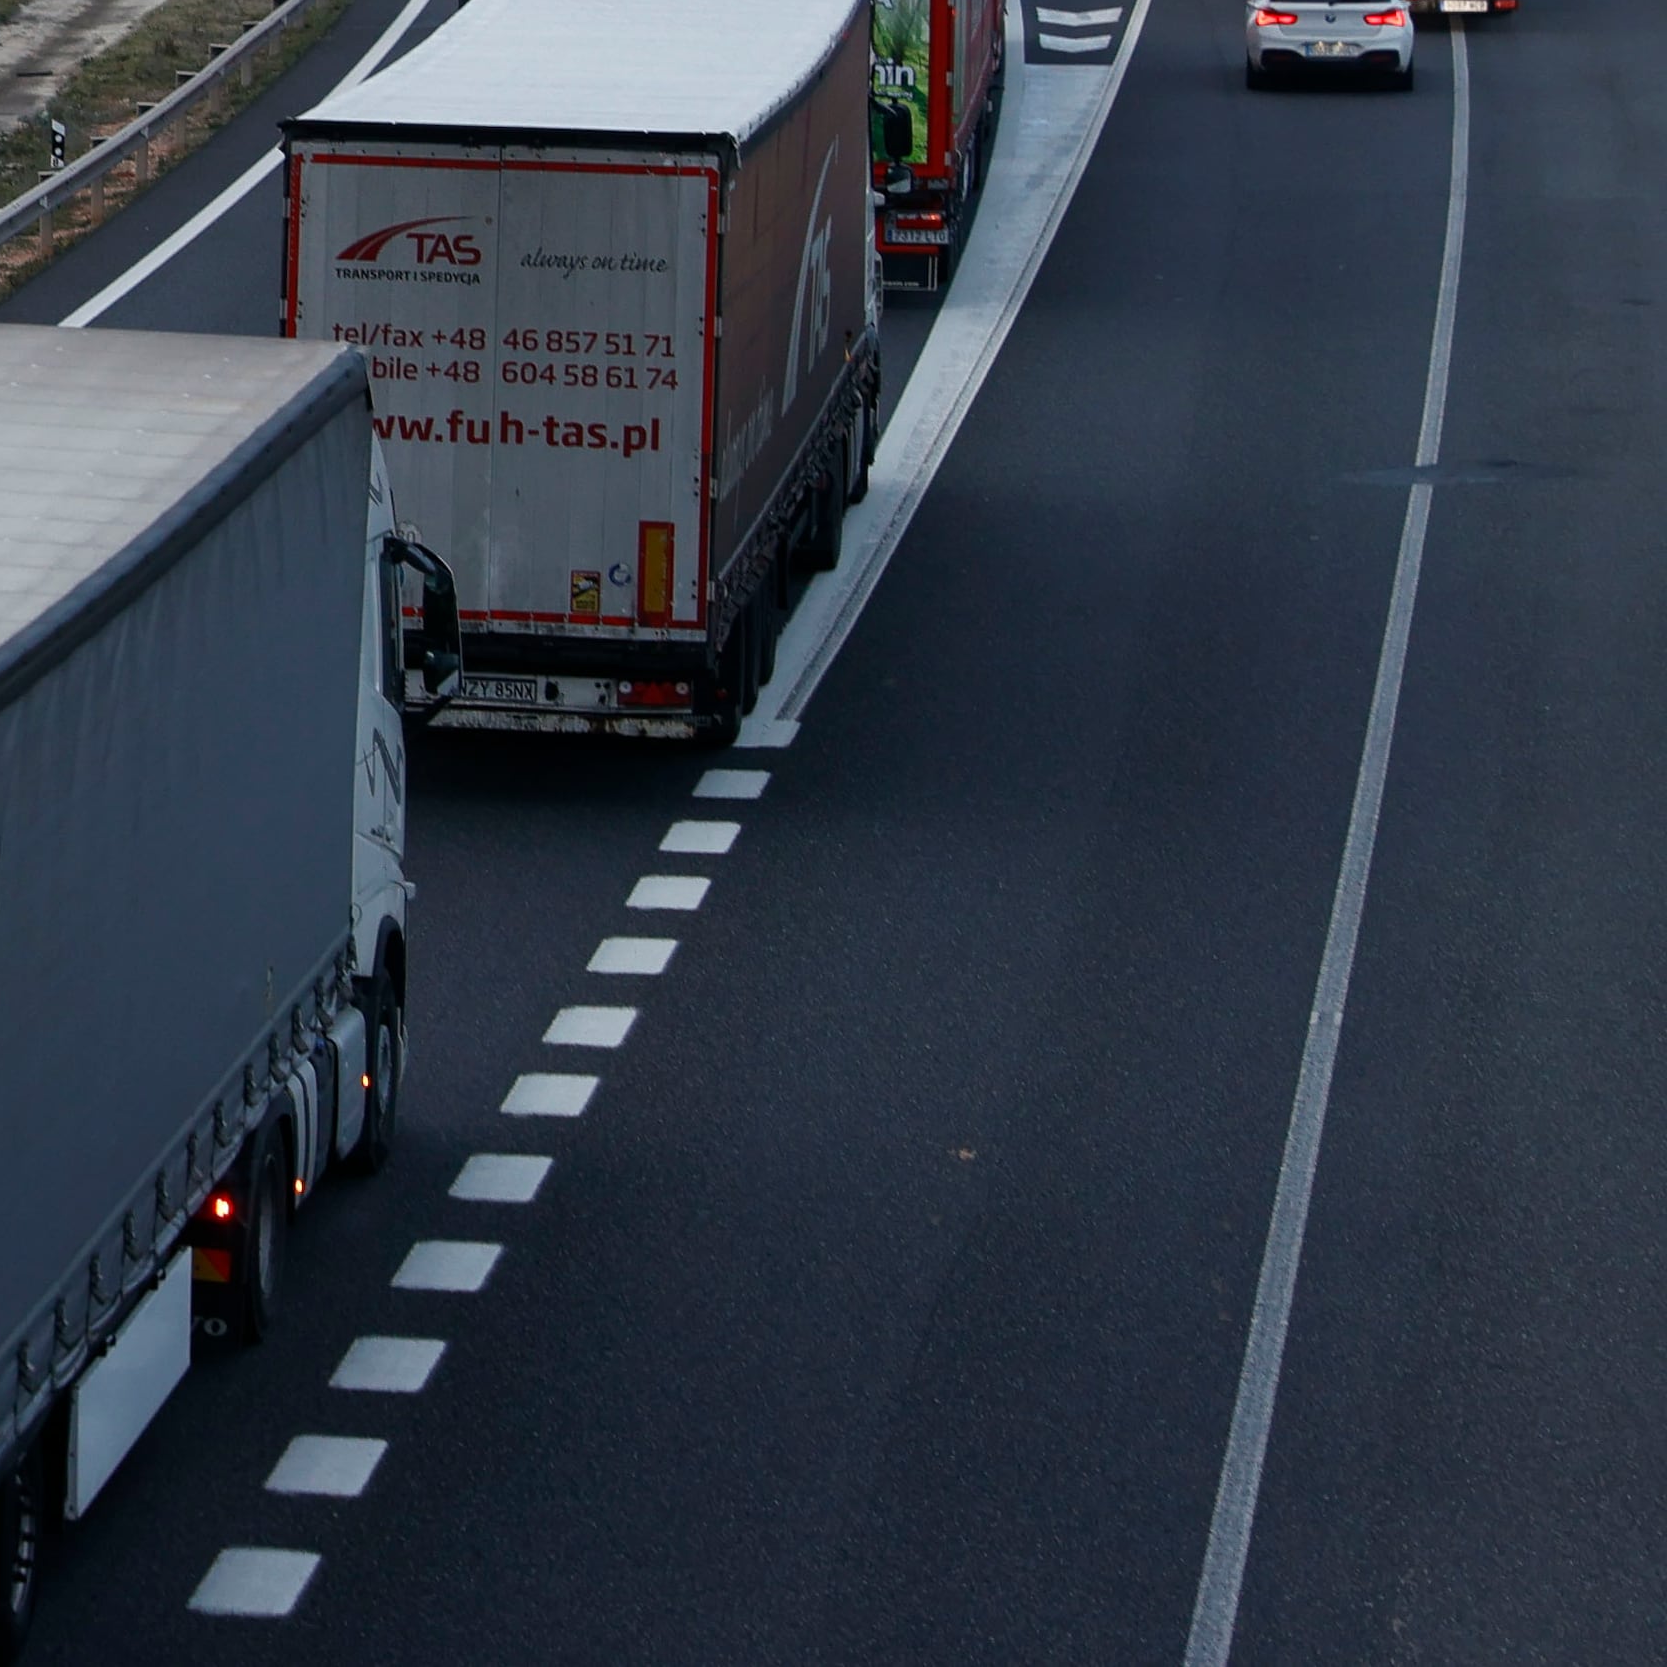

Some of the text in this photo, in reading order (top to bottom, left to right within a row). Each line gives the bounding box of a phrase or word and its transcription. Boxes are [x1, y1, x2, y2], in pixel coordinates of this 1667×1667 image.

[405, 233, 482, 265] TAS
[519, 246, 668, 280] always on time
[335, 267, 413, 282] TRANSPORT
[420, 272, 481, 286] SPEDYCJA
[332, 322, 676, 359] tel/fax +48 46 857 51 71
[371, 355, 679, 391] bile +48 604 58 61 74
[371, 408, 661, 458] ww.fuh-tas.pl
[495, 680, 534, 702] 85NX
